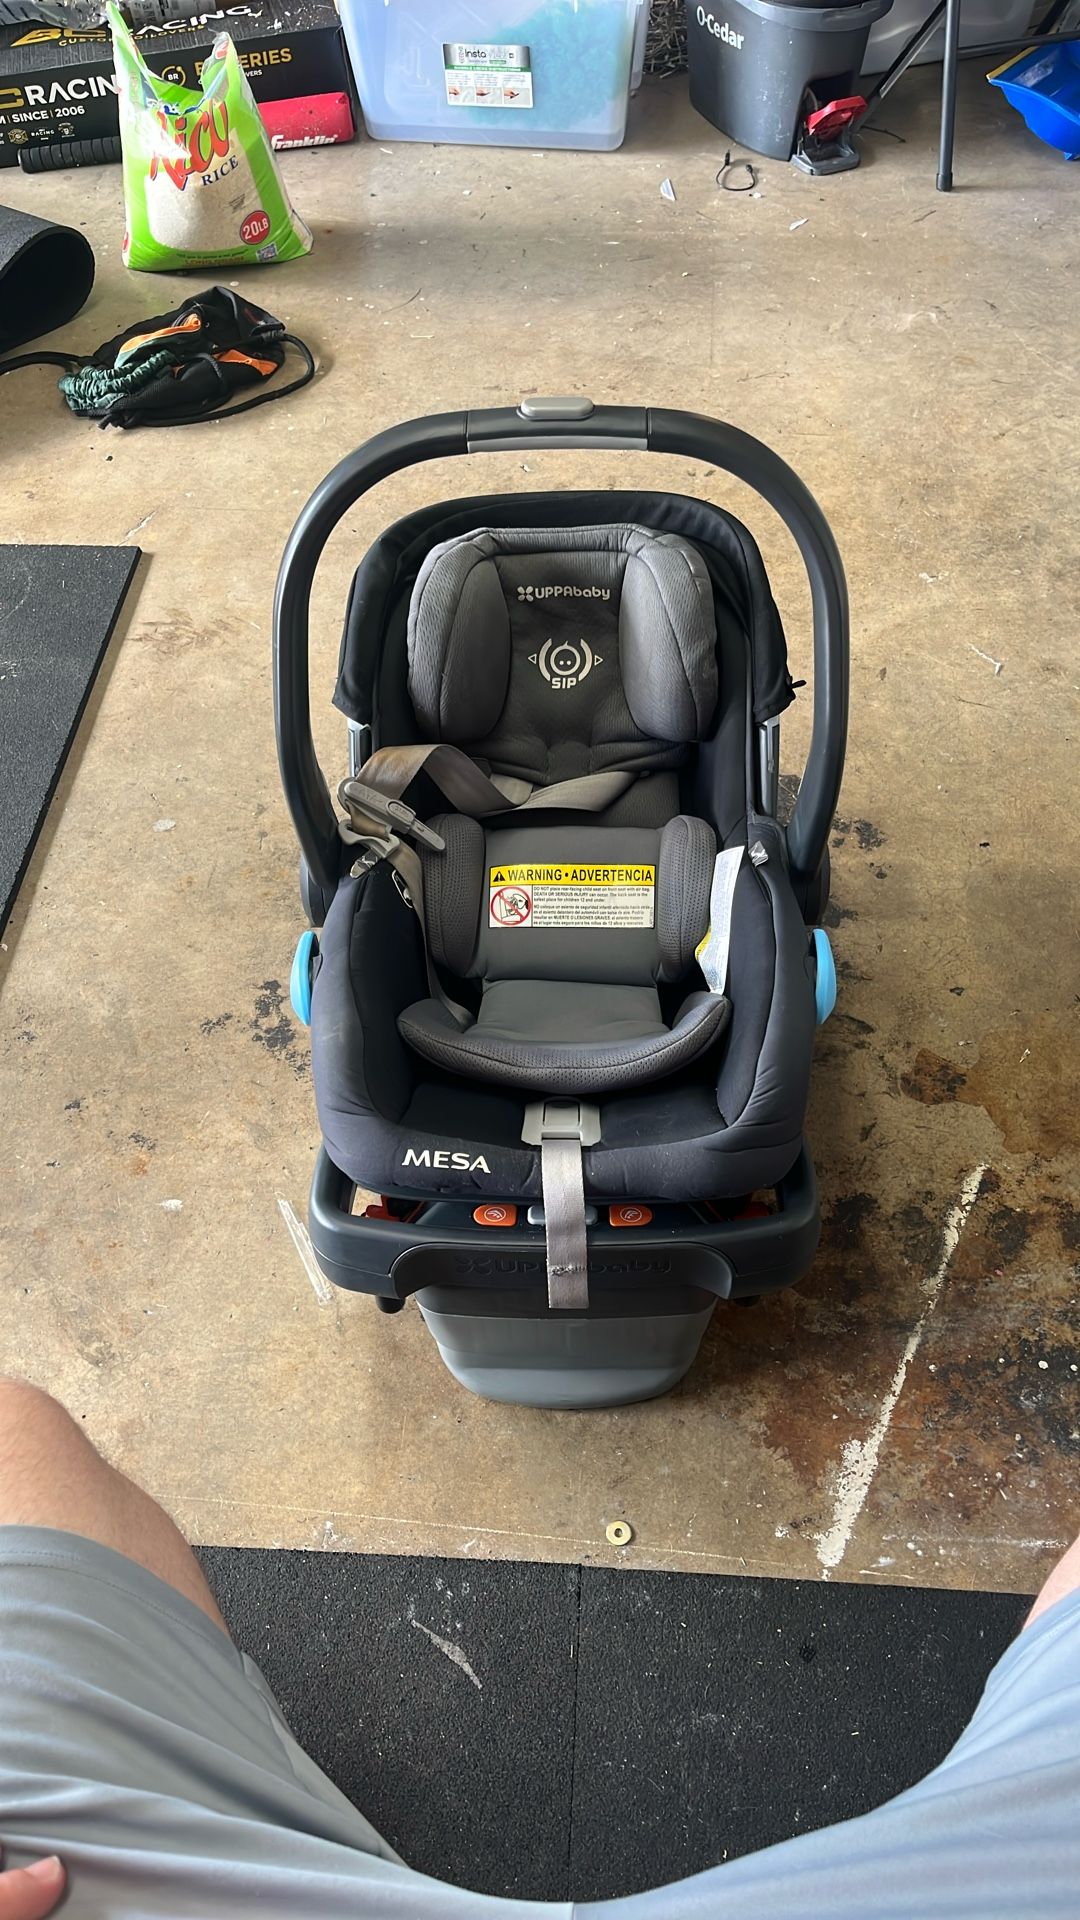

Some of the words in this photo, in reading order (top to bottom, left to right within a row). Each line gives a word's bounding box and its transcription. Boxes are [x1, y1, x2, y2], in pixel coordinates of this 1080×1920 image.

[129, 5, 253, 35] ACING
[696, 5, 745, 50] O-Cedar
[59, 37, 113, 47] CUSTO
[134, 25, 205, 40] OILOVERS
[238, 47, 292, 69] ERIES
[24, 74, 119, 106] RACIN
[11, 110, 49, 124] SINCE
[54, 105, 85, 118] 2006
[202, 155, 239, 186] RICE
[535, 586, 611, 600] UPPAbaby
[551, 677, 577, 689] SIP
[507, 868, 562, 882] WARNING
[570, 868, 653, 882] ADVERTENCIA
[402, 1149, 491, 1174] MESA
